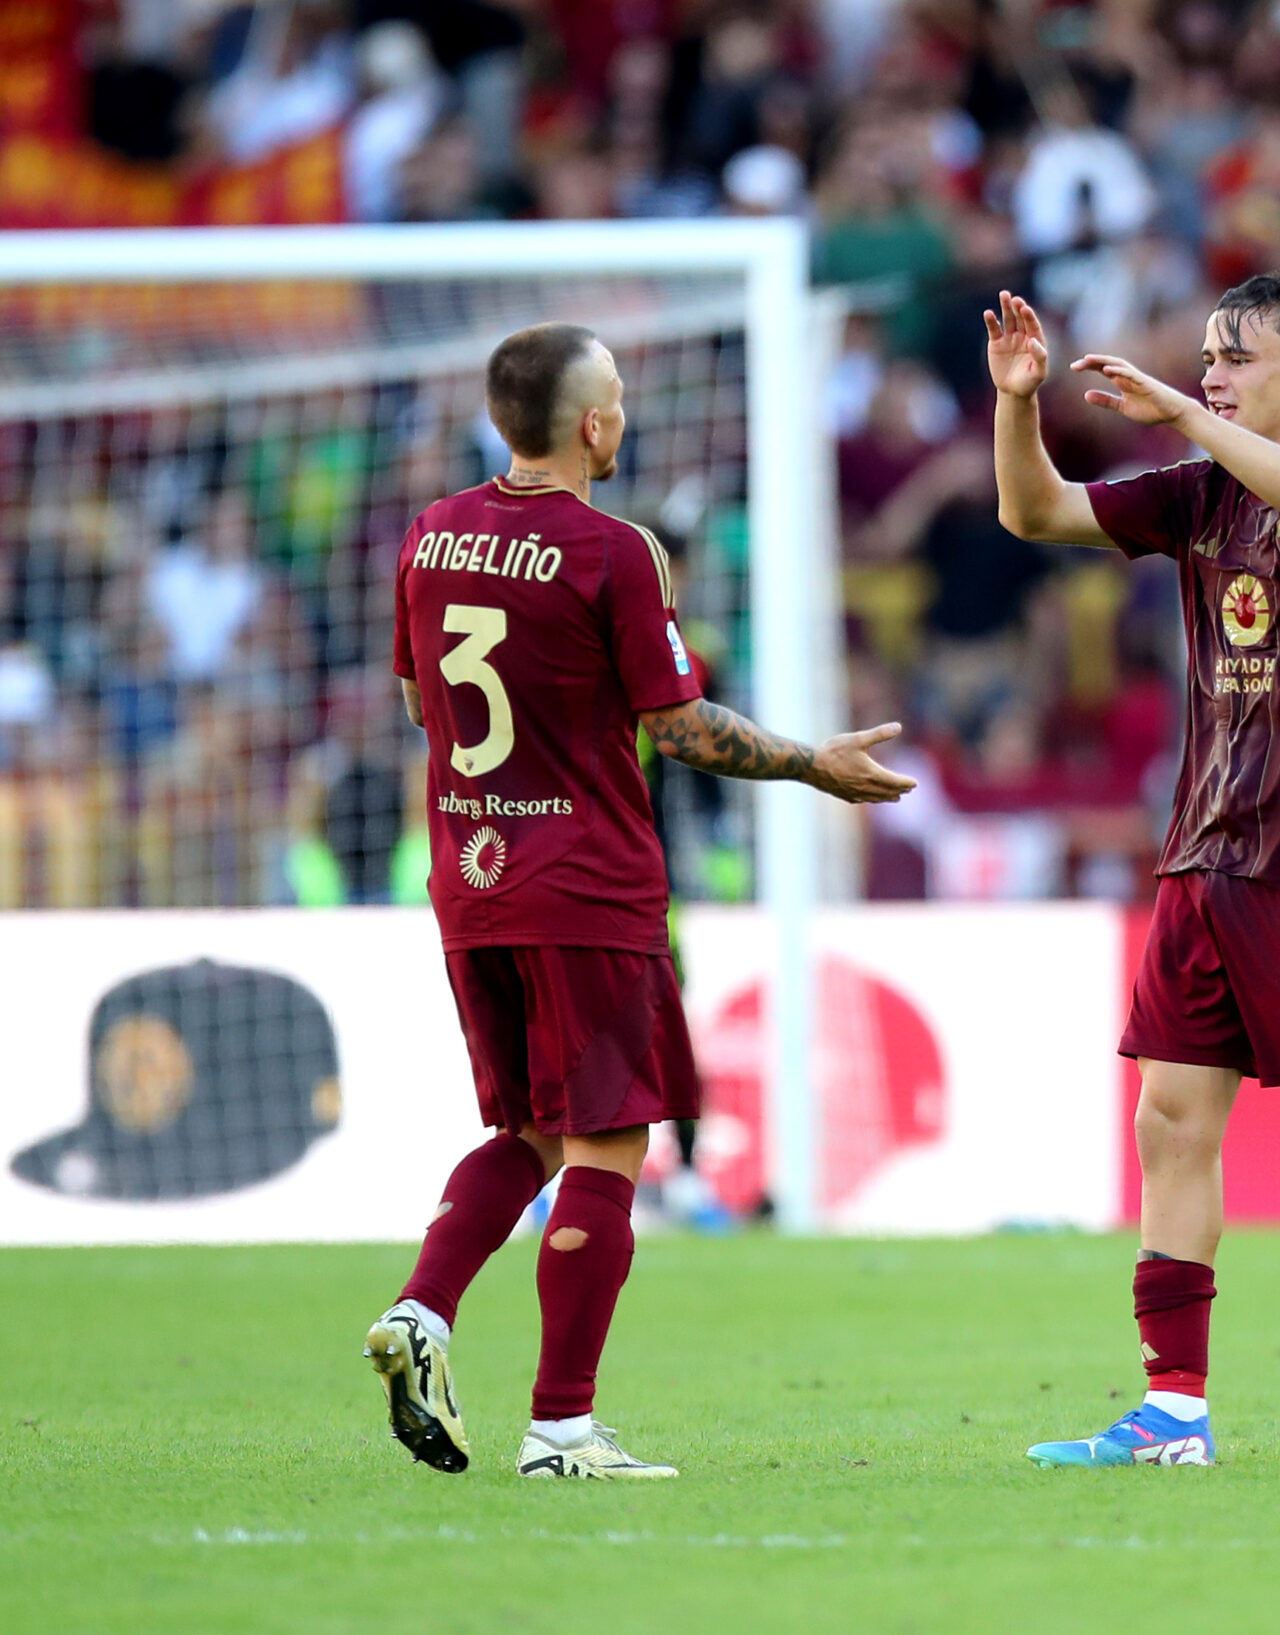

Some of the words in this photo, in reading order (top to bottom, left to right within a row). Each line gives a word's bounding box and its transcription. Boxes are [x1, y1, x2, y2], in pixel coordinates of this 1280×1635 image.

[412, 531, 562, 582] ANGELIÑO
[1216, 658, 1277, 674] RIYADH
[440, 604, 514, 777] 3
[485, 794, 573, 816] Resorts
